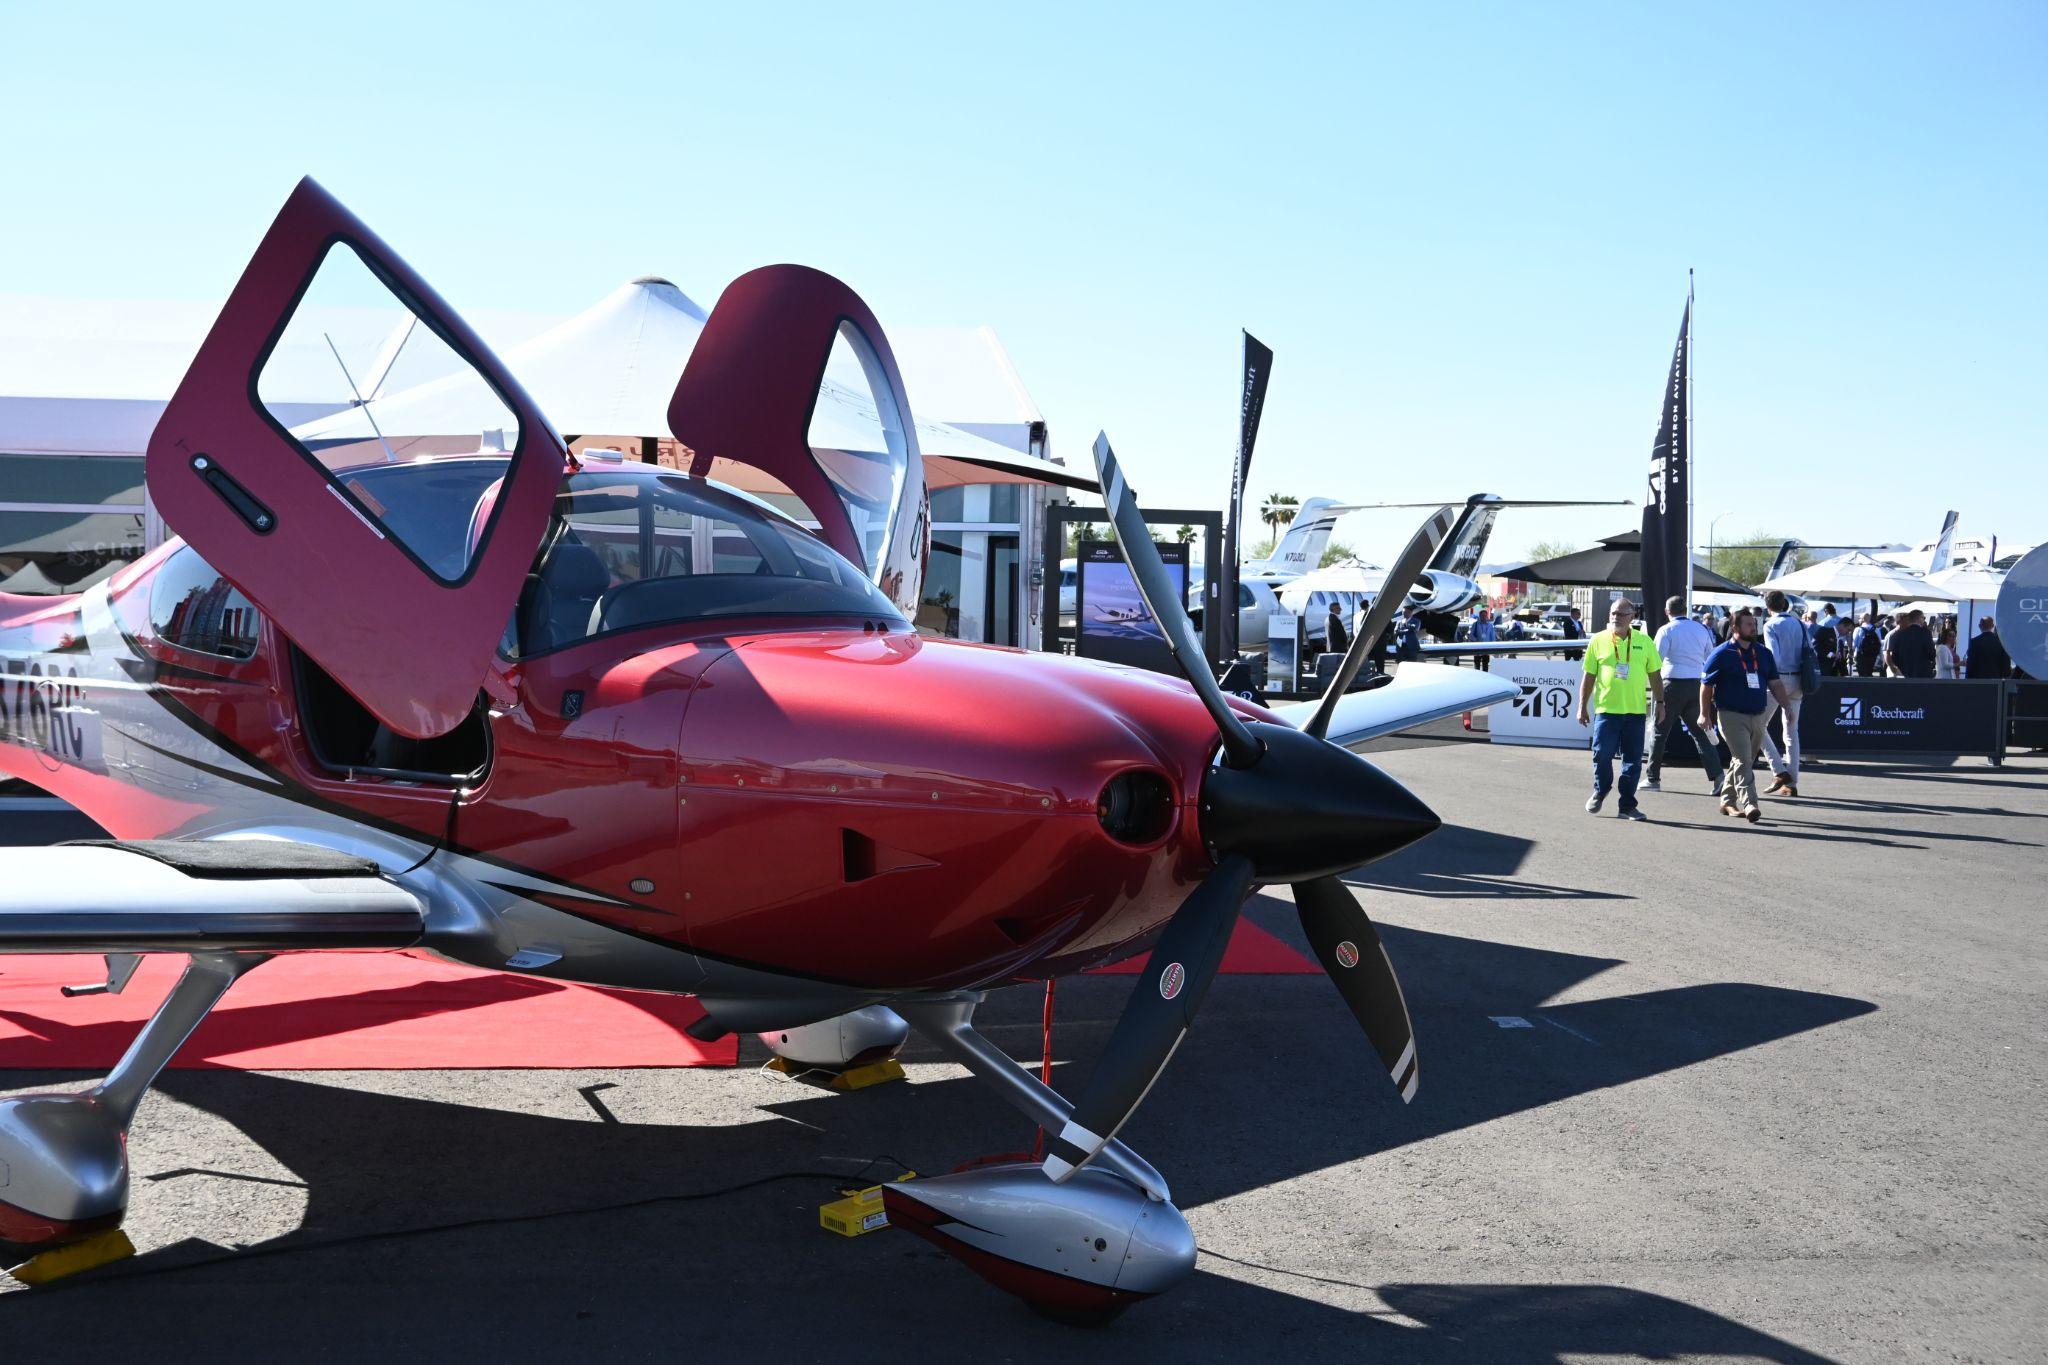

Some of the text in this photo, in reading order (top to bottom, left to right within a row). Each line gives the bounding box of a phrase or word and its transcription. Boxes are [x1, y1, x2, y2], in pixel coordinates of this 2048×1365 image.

[1674, 340, 1683, 399] AVIATION
[1673, 469, 1679, 483] BY
[1512, 676, 1575, 687] MEDIA CHECK-IN
[1871, 705, 1925, 719] Beechcraft
[1834, 717, 1861, 726] Cessna
